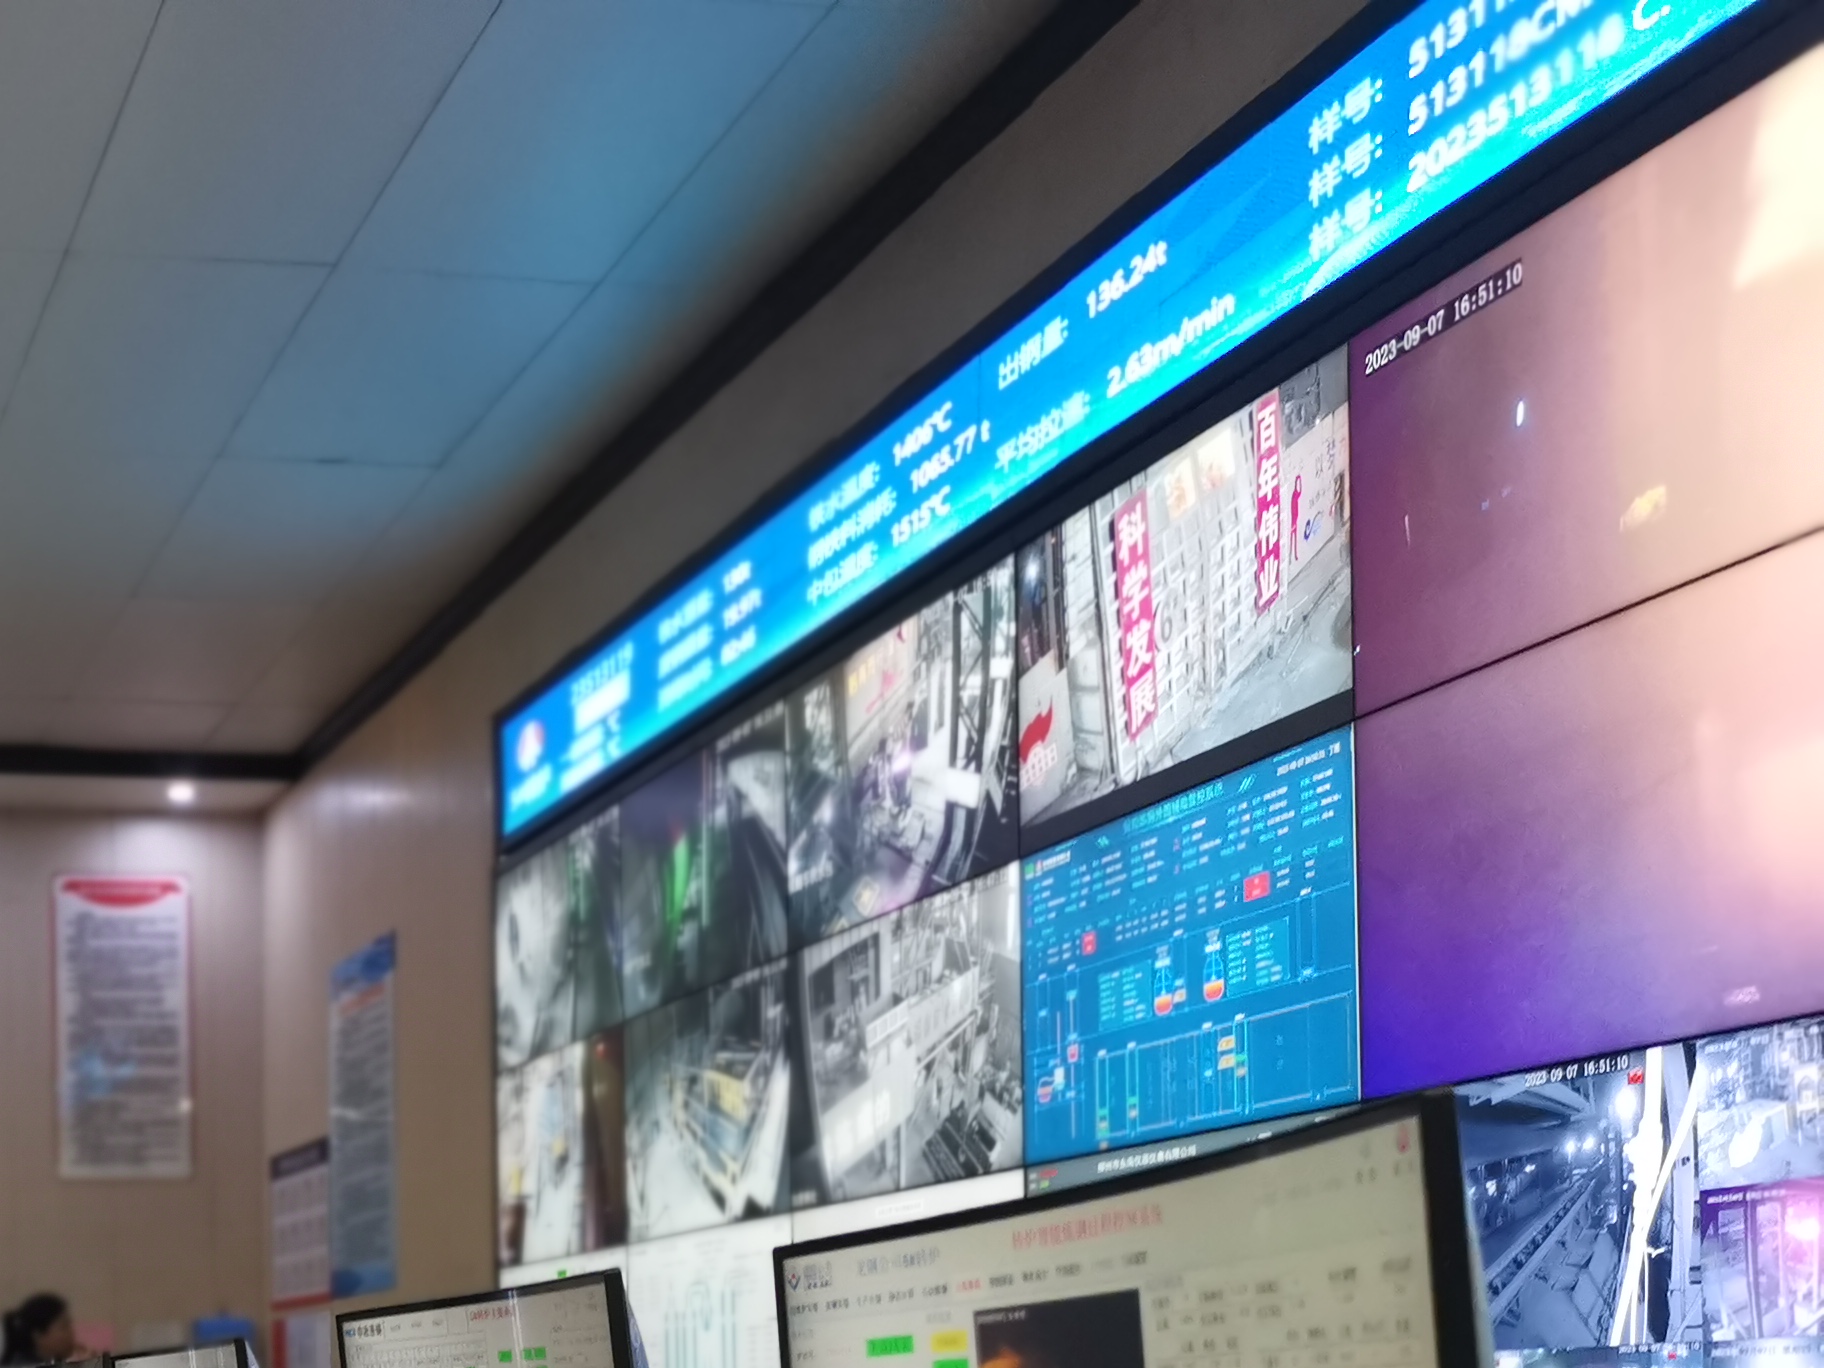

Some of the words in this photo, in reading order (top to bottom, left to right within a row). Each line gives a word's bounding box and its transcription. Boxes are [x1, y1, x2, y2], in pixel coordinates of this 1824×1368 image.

[1086, 241, 1167, 318] 136.24t
[1364, 311, 1446, 377] 2023-09-07
[1452, 262, 1524, 323] 16:51:10
[1107, 293, 1236, 398] 2.63m/min
[1256, 404, 1280, 609] 百年伟业
[1116, 503, 1158, 737] 科学发展
